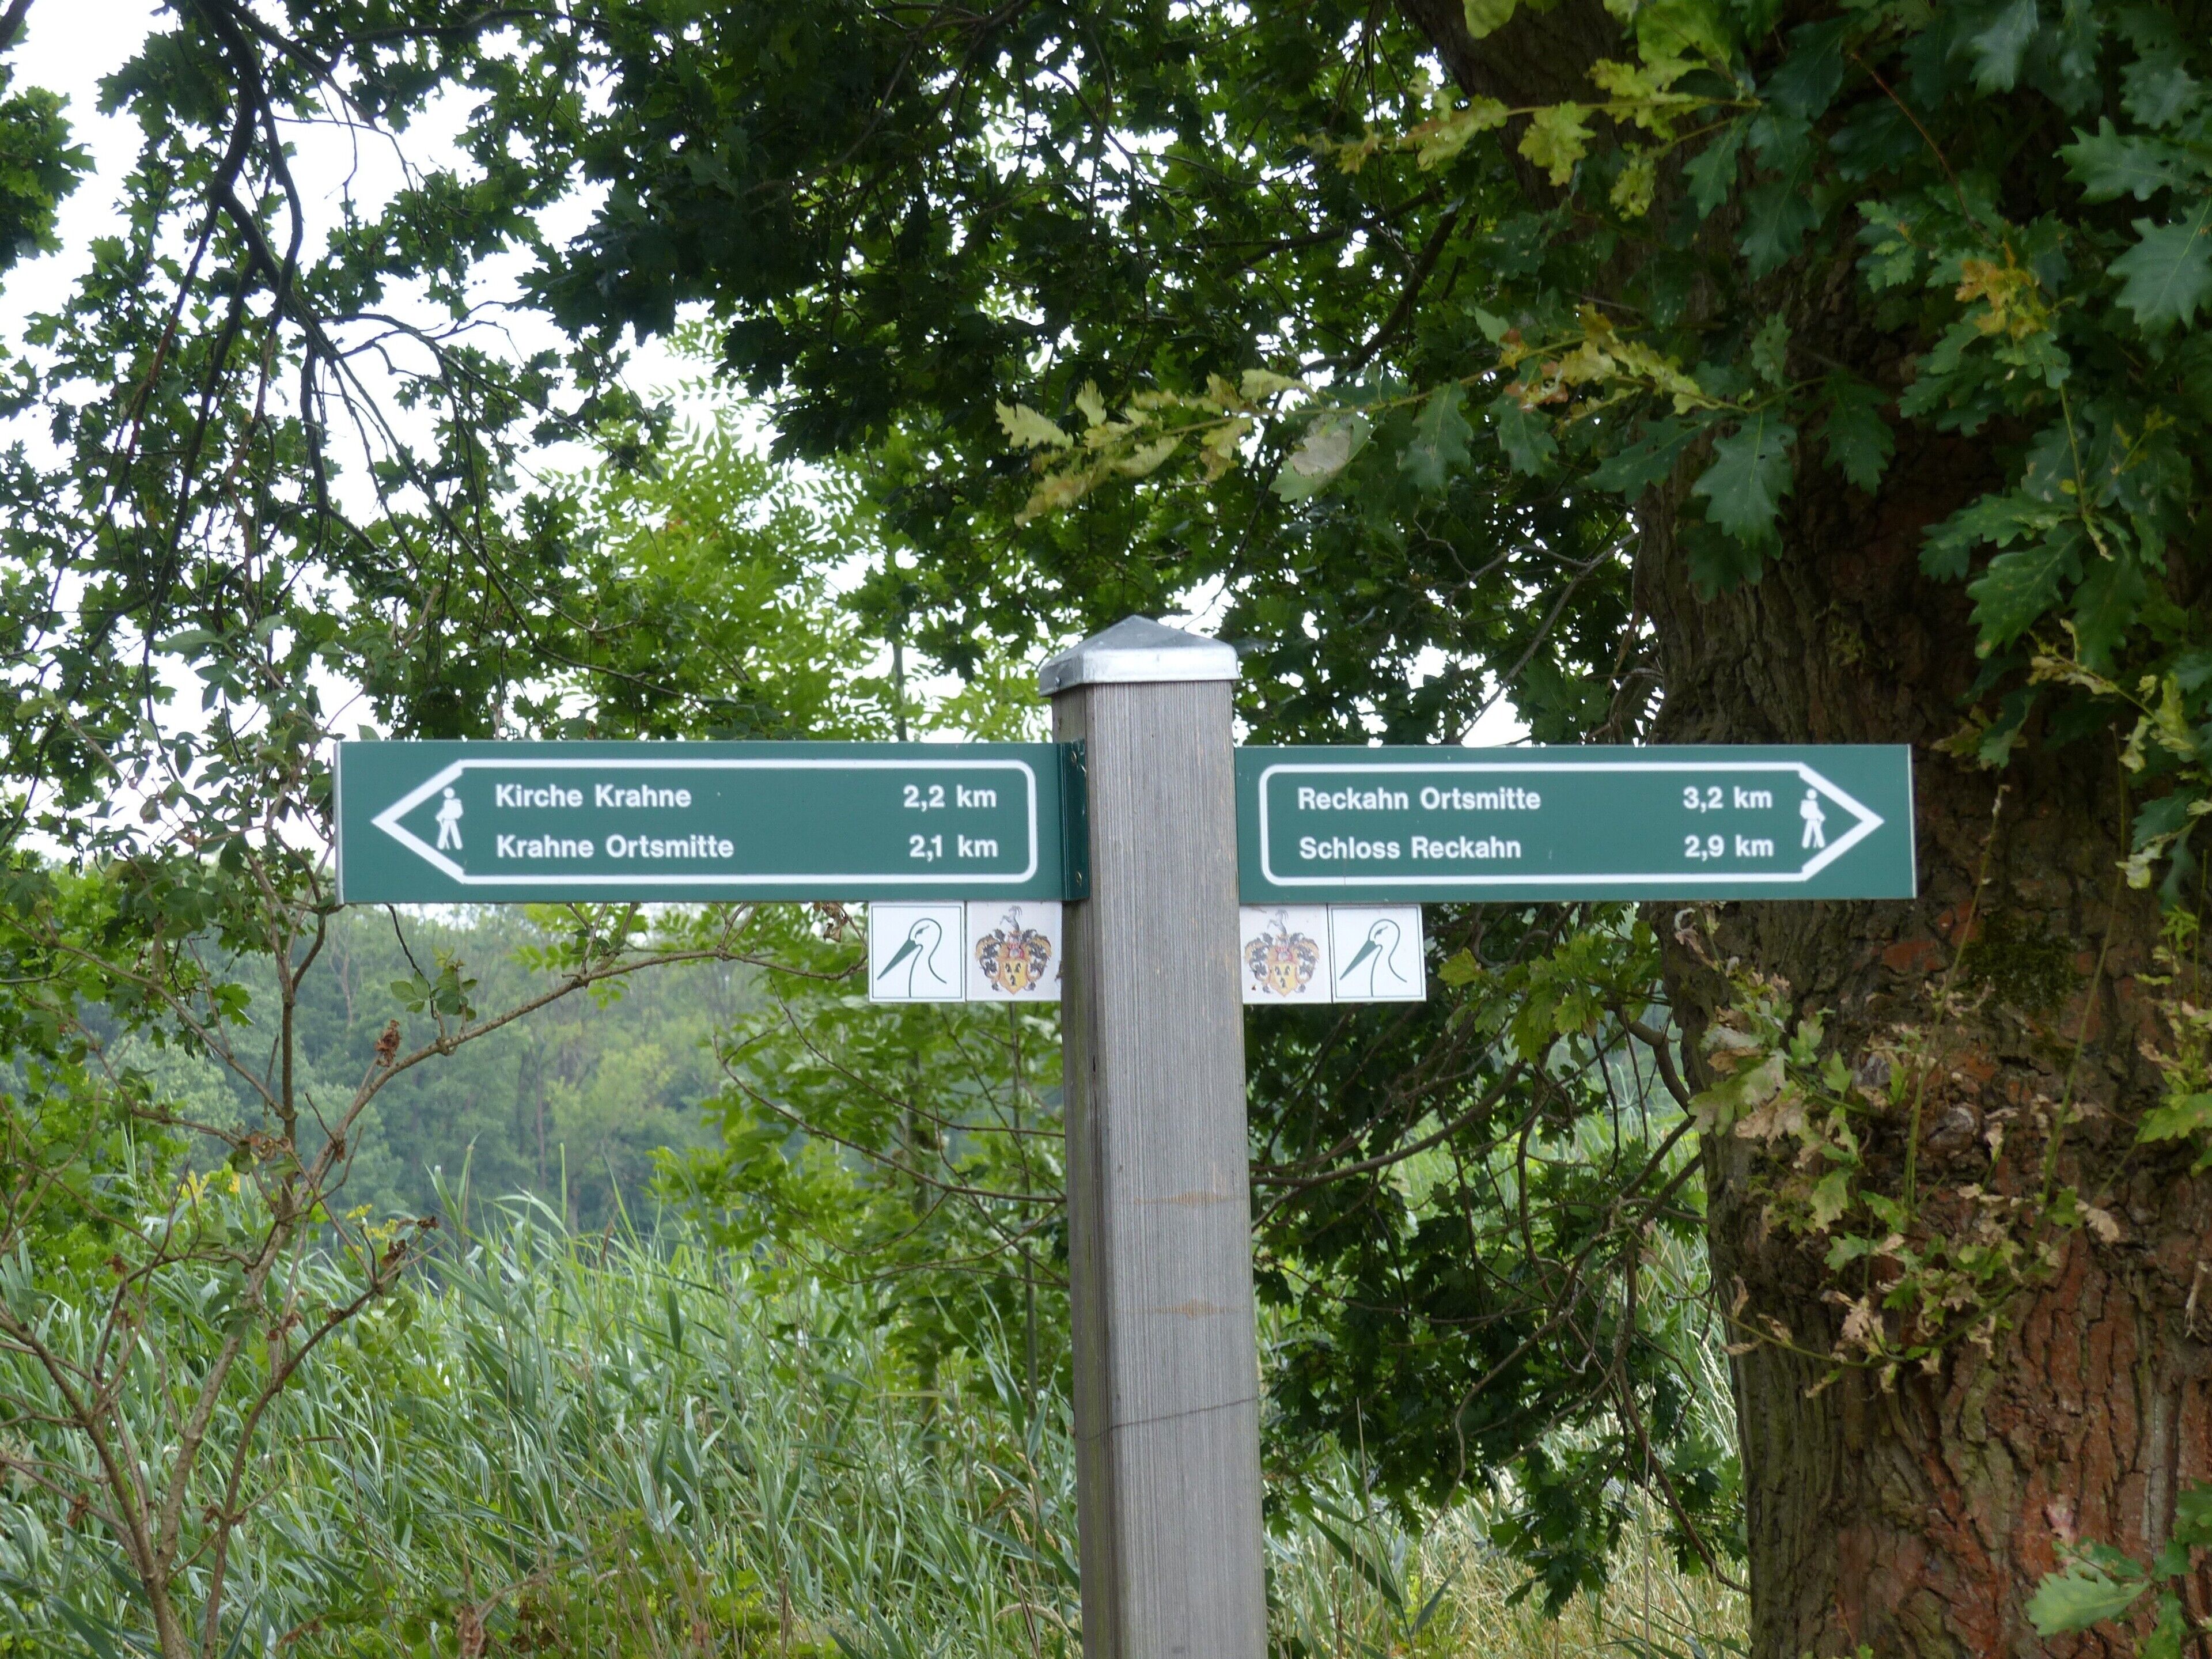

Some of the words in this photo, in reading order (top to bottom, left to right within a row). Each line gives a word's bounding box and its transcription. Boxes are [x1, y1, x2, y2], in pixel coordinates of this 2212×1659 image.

[495, 783, 584, 808] Kirche
[594, 783, 692, 808] Krahne
[903, 784, 946, 812] 2,2
[956, 784, 998, 808] km
[1297, 786, 1410, 810] Reckahn
[1419, 786, 1541, 810] Ortsmitte
[1683, 786, 1724, 813] 3,2
[1733, 786, 1773, 809] km
[497, 834, 594, 858] Krahne
[605, 834, 734, 858] Ortsmitte
[909, 834, 943, 862] 2,1
[957, 834, 999, 858] km
[1299, 836, 1401, 860] Schloss
[1411, 835, 1522, 859] Reckahn
[1684, 834, 1725, 862] 2,9
[1734, 834, 1774, 857] km
